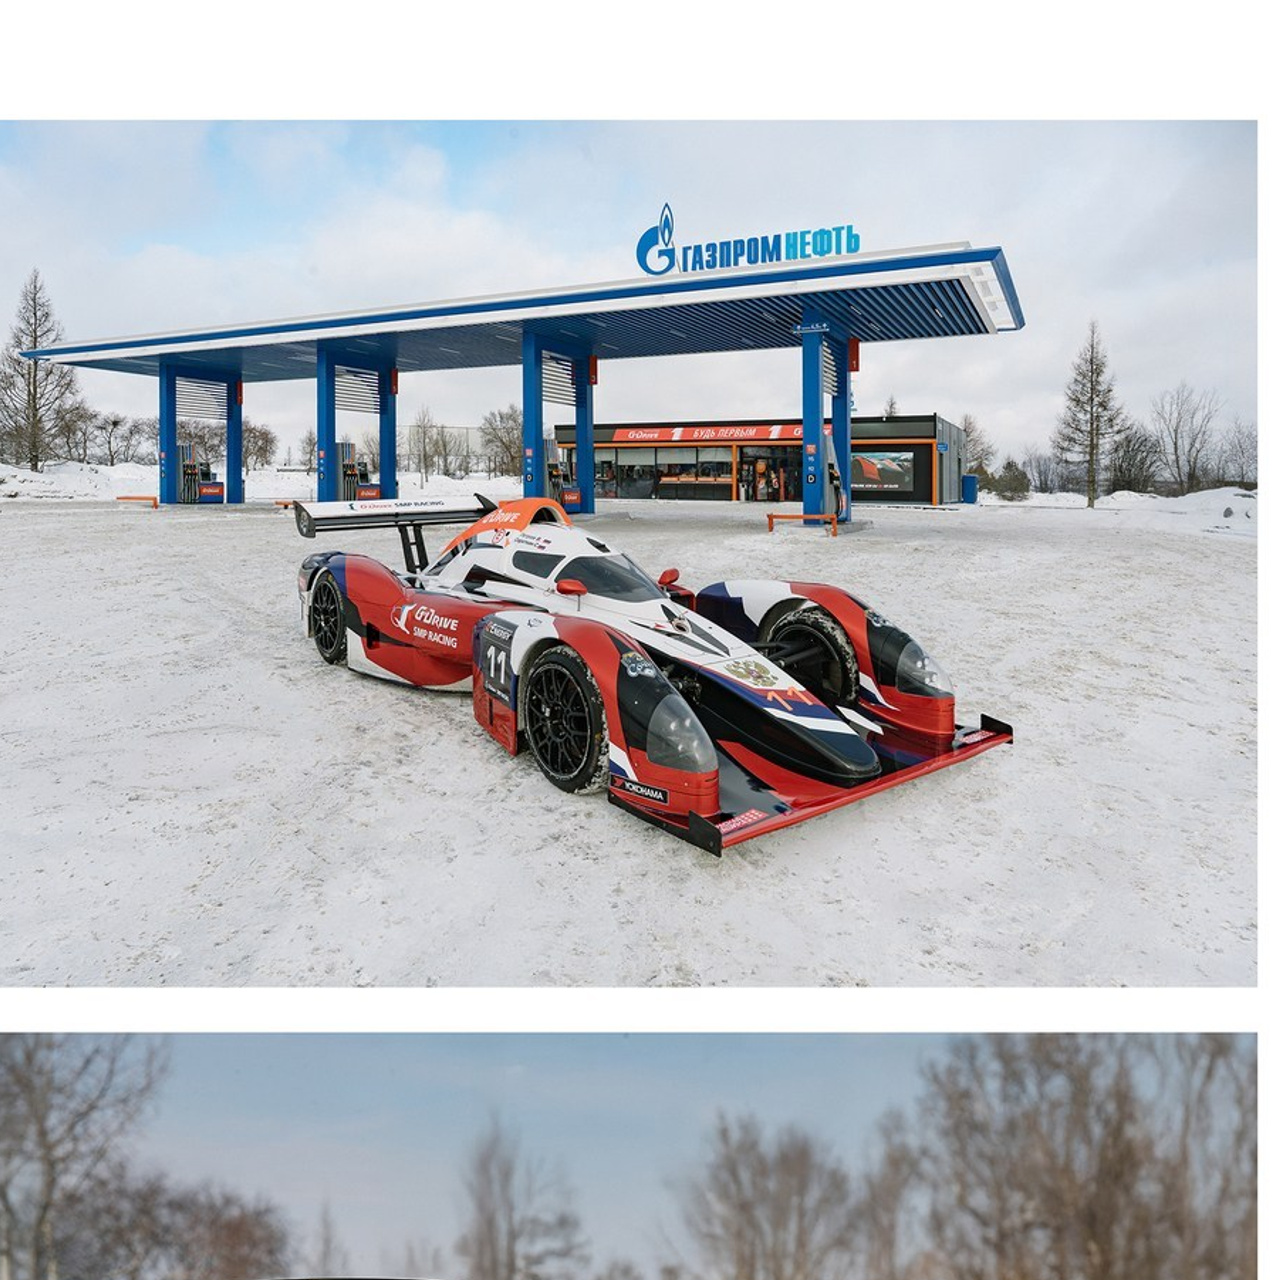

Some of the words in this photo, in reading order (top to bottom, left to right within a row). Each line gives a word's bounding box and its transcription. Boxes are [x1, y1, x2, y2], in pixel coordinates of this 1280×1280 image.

[692, 429, 716, 439] БУДЬ
[717, 428, 757, 438] ПЕРВЫМ
[414, 605, 459, 631] G-DRIVE
[413, 626, 428, 638] SMP
[428, 632, 458, 649] RACING
[487, 645, 507, 684] 11
[767, 686, 813, 711] 11
[624, 780, 664, 801] YOKOHAMA
